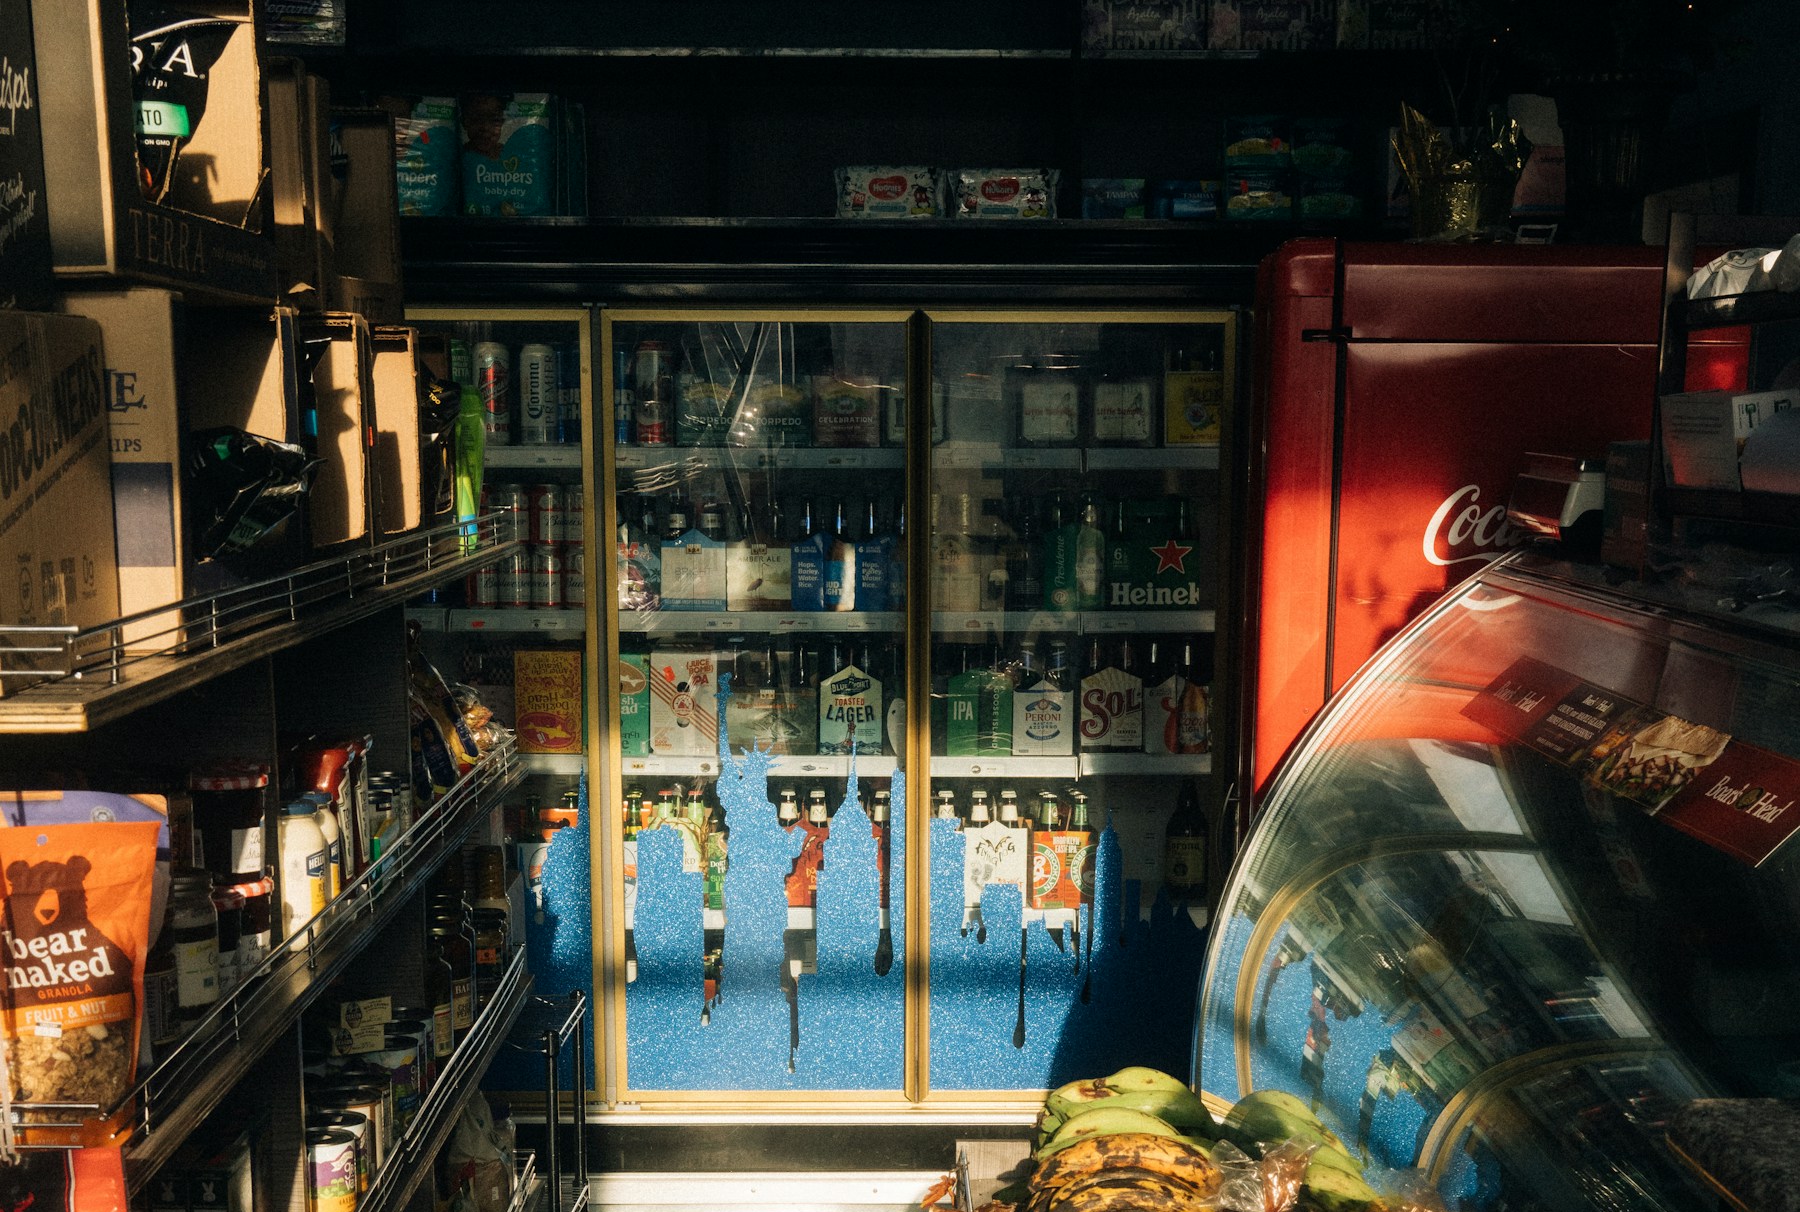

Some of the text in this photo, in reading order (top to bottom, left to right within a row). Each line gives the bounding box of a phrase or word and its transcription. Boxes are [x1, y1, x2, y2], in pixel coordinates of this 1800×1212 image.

[476, 164, 533, 186] Pampers
[484, 186, 526, 197] baby-dry
[128, 208, 209, 273] TERRA
[527, 361, 544, 420] Corona
[545, 353, 554, 425] PREMIER
[756, 416, 802, 426] TORPEDO
[818, 416, 873, 424] CELEBRATION
[1054, 535, 1065, 587] Presidente
[1113, 547, 1123, 561] 6
[1110, 581, 1200, 605] Heinek
[528, 692, 559, 704] Head
[531, 702, 569, 711] Dogfish
[834, 697, 865, 706] TOASTED
[826, 705, 875, 723] LAGER
[953, 701, 974, 721] IPA
[1025, 712, 1061, 722] PERONI
[1745, 791, 1795, 825] Head
[1043, 848, 1058, 892] BROOKLYN
[2, 928, 88, 960] bear
[5, 947, 115, 989] naked
[38, 984, 93, 1000] GRANOLA
[25, 1007, 64, 1024] FRUIT
[68, 1005, 79, 1018] &
[81, 1001, 106, 1016] NUT
